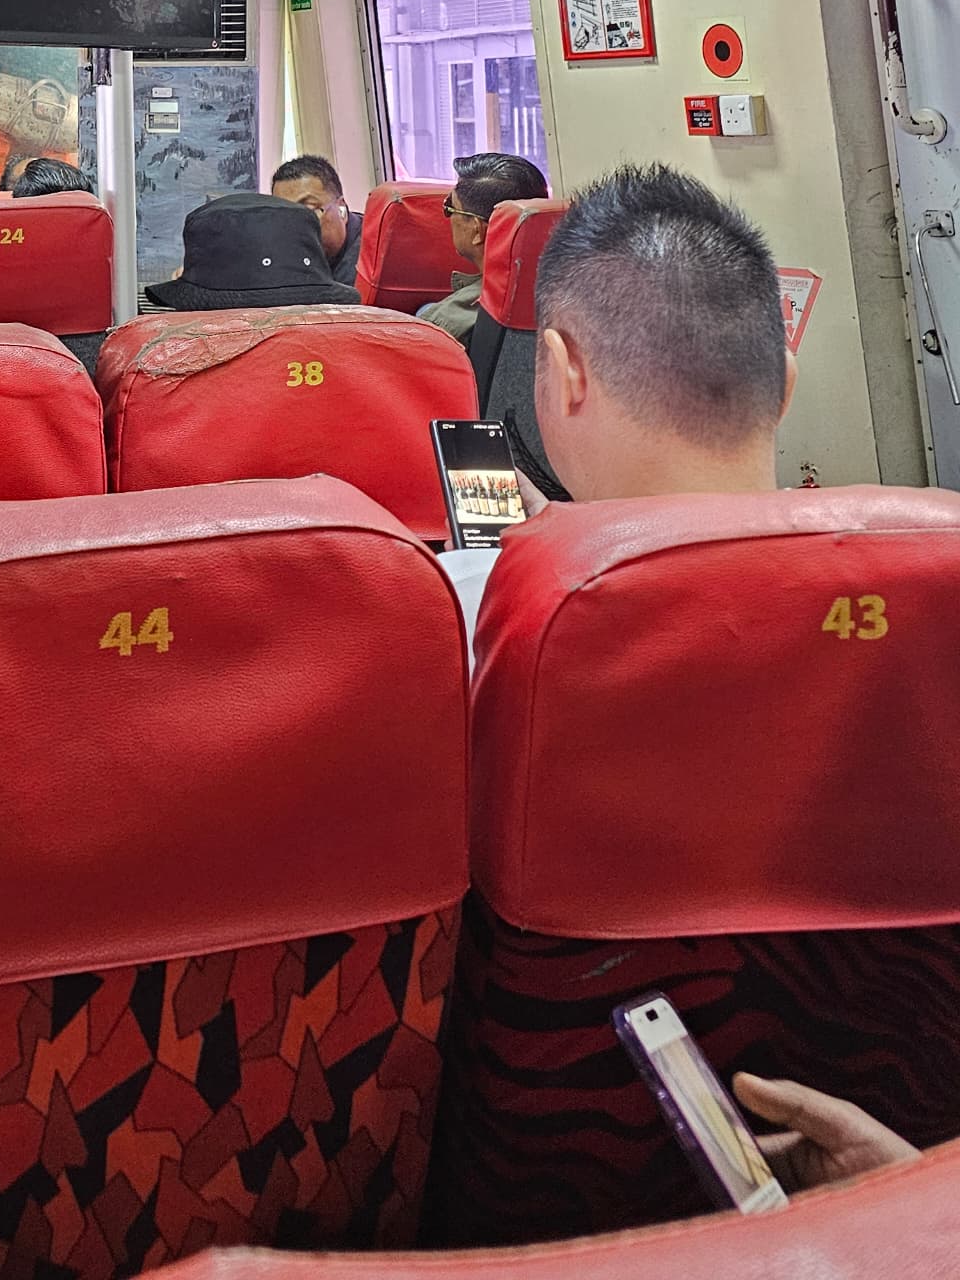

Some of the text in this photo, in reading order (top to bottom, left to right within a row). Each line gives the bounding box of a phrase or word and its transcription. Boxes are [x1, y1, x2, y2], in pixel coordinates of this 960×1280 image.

[0, 228, 25, 245] 24
[286, 361, 325, 387] 38
[98, 607, 174, 656] 44
[821, 595, 888, 639] 43
